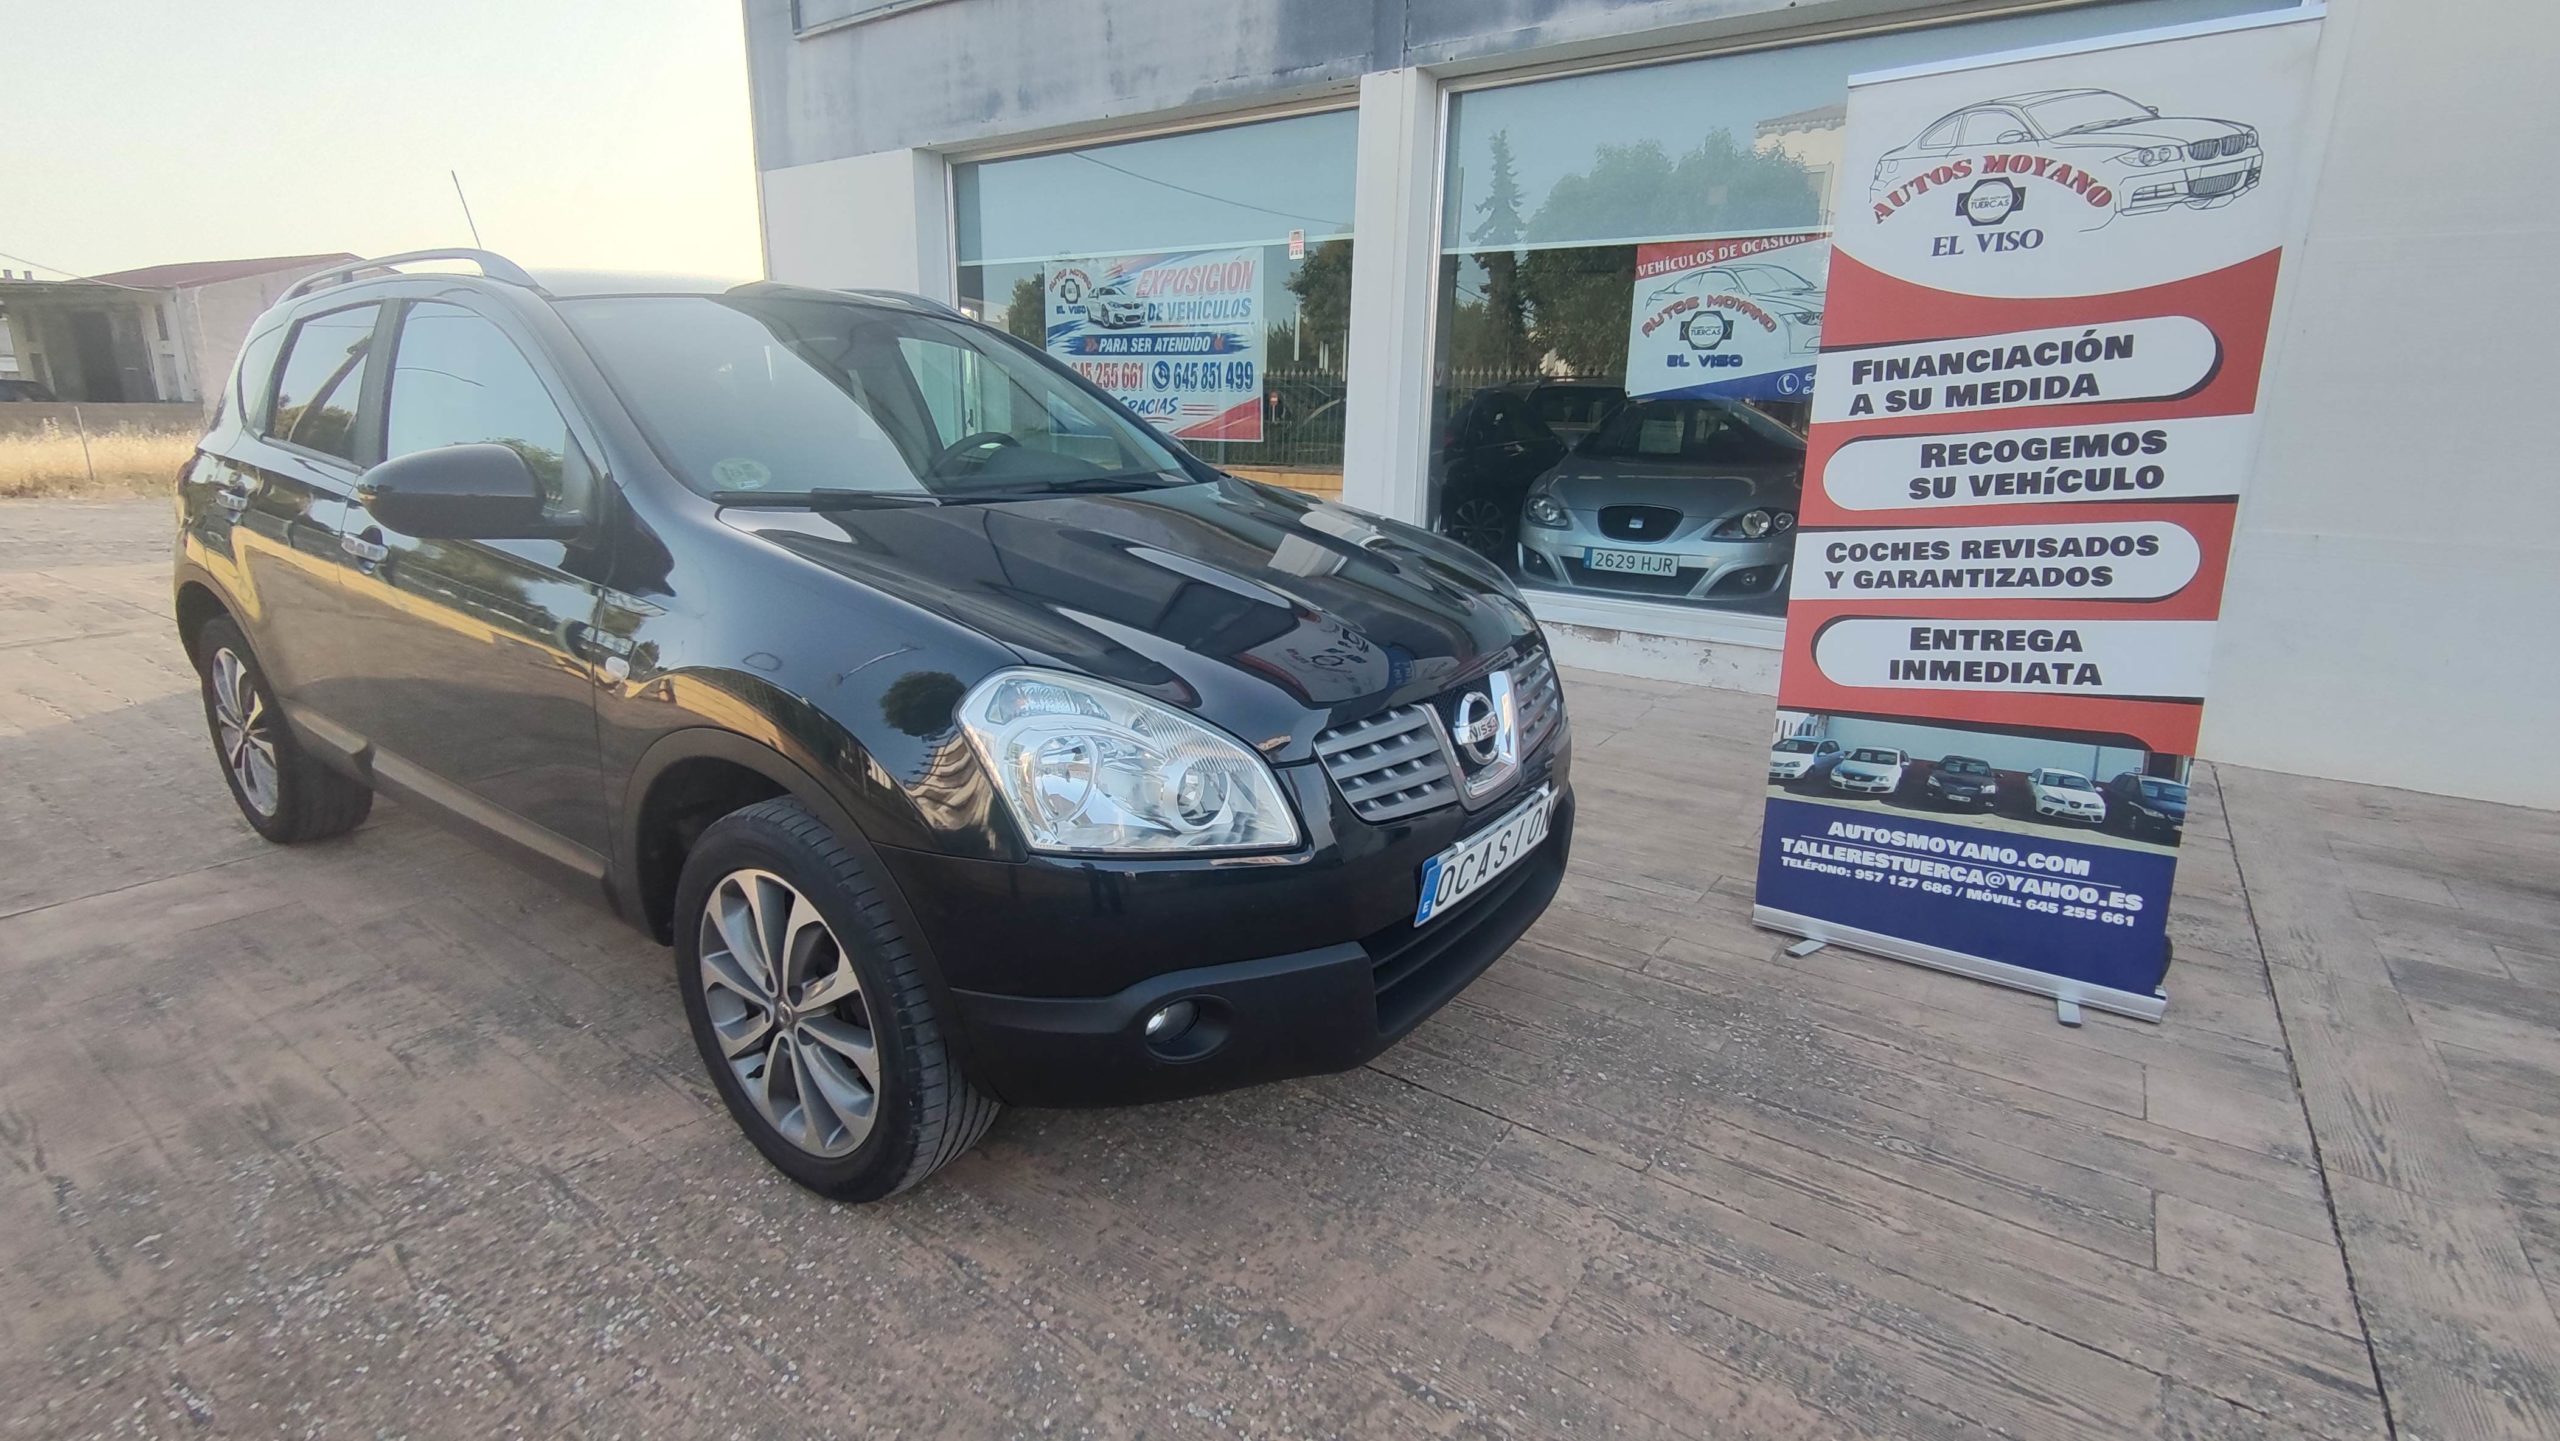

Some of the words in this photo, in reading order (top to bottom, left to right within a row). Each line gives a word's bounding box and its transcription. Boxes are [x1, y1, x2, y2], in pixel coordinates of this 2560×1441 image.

[1874, 159, 1972, 224] AUTOS
[1981, 154, 2112, 208] MOYANO
[1931, 236, 1965, 256] EL
[1976, 229, 2043, 252] VISO
[1637, 249, 1715, 277] VEHÍCULOS
[1719, 244, 1738, 260] DE
[1136, 256, 1256, 297] EXPOSICIÓN
[1147, 302, 1162, 321] DE
[1167, 296, 1252, 321] VEHÍCULOS
[1641, 296, 1699, 337] AUTOS
[1707, 294, 1777, 333] MOYANO
[1098, 337, 1128, 353] PARA
[1130, 336, 1152, 352] SER
[1852, 329, 2134, 385] FINANCIACIÓN
[1096, 362, 1118, 389] 255
[1122, 362, 1144, 389] 661
[1173, 362, 1198, 390] 645
[1200, 362, 1222, 390] 851
[1225, 361, 1254, 390] 499
[1667, 354, 1690, 368] EL
[1698, 355, 1743, 368] VISO
[1849, 394, 1874, 416] A
[1885, 388, 1932, 413] SU
[1945, 373, 2100, 408] MEDIDA
[1920, 429, 2168, 468] RECOGEMOS
[1909, 476, 1956, 499] SU
[1595, 552, 1635, 570] 2629
[1641, 556, 1673, 573] HJR
[1826, 540, 1950, 564] COCHES
[1961, 535, 2160, 560] REVISADOS
[1824, 571, 1844, 589] Y
[1853, 566, 2113, 589] GARANTIZADOS
[1909, 627, 2083, 653] ENTREGA
[1889, 660, 2103, 686] INMEDIATA
[1828, 821, 2091, 877] AUTOSMOYANO.COM
[1781, 837, 2143, 911] TALLERESTUERCA@YAHOO.ES
[1781, 856, 1851, 877] TELÉFONO:
[1855, 868, 1884, 883] 957
[1888, 874, 1919, 889] 127
[1921, 881, 1953, 895] 686
[1955, 887, 1964, 898] /
[1966, 886, 2022, 908] MÓVIL:
[2026, 898, 2059, 914] 645
[2062, 904, 2097, 920] 255
[2101, 911, 2135, 927] 661
